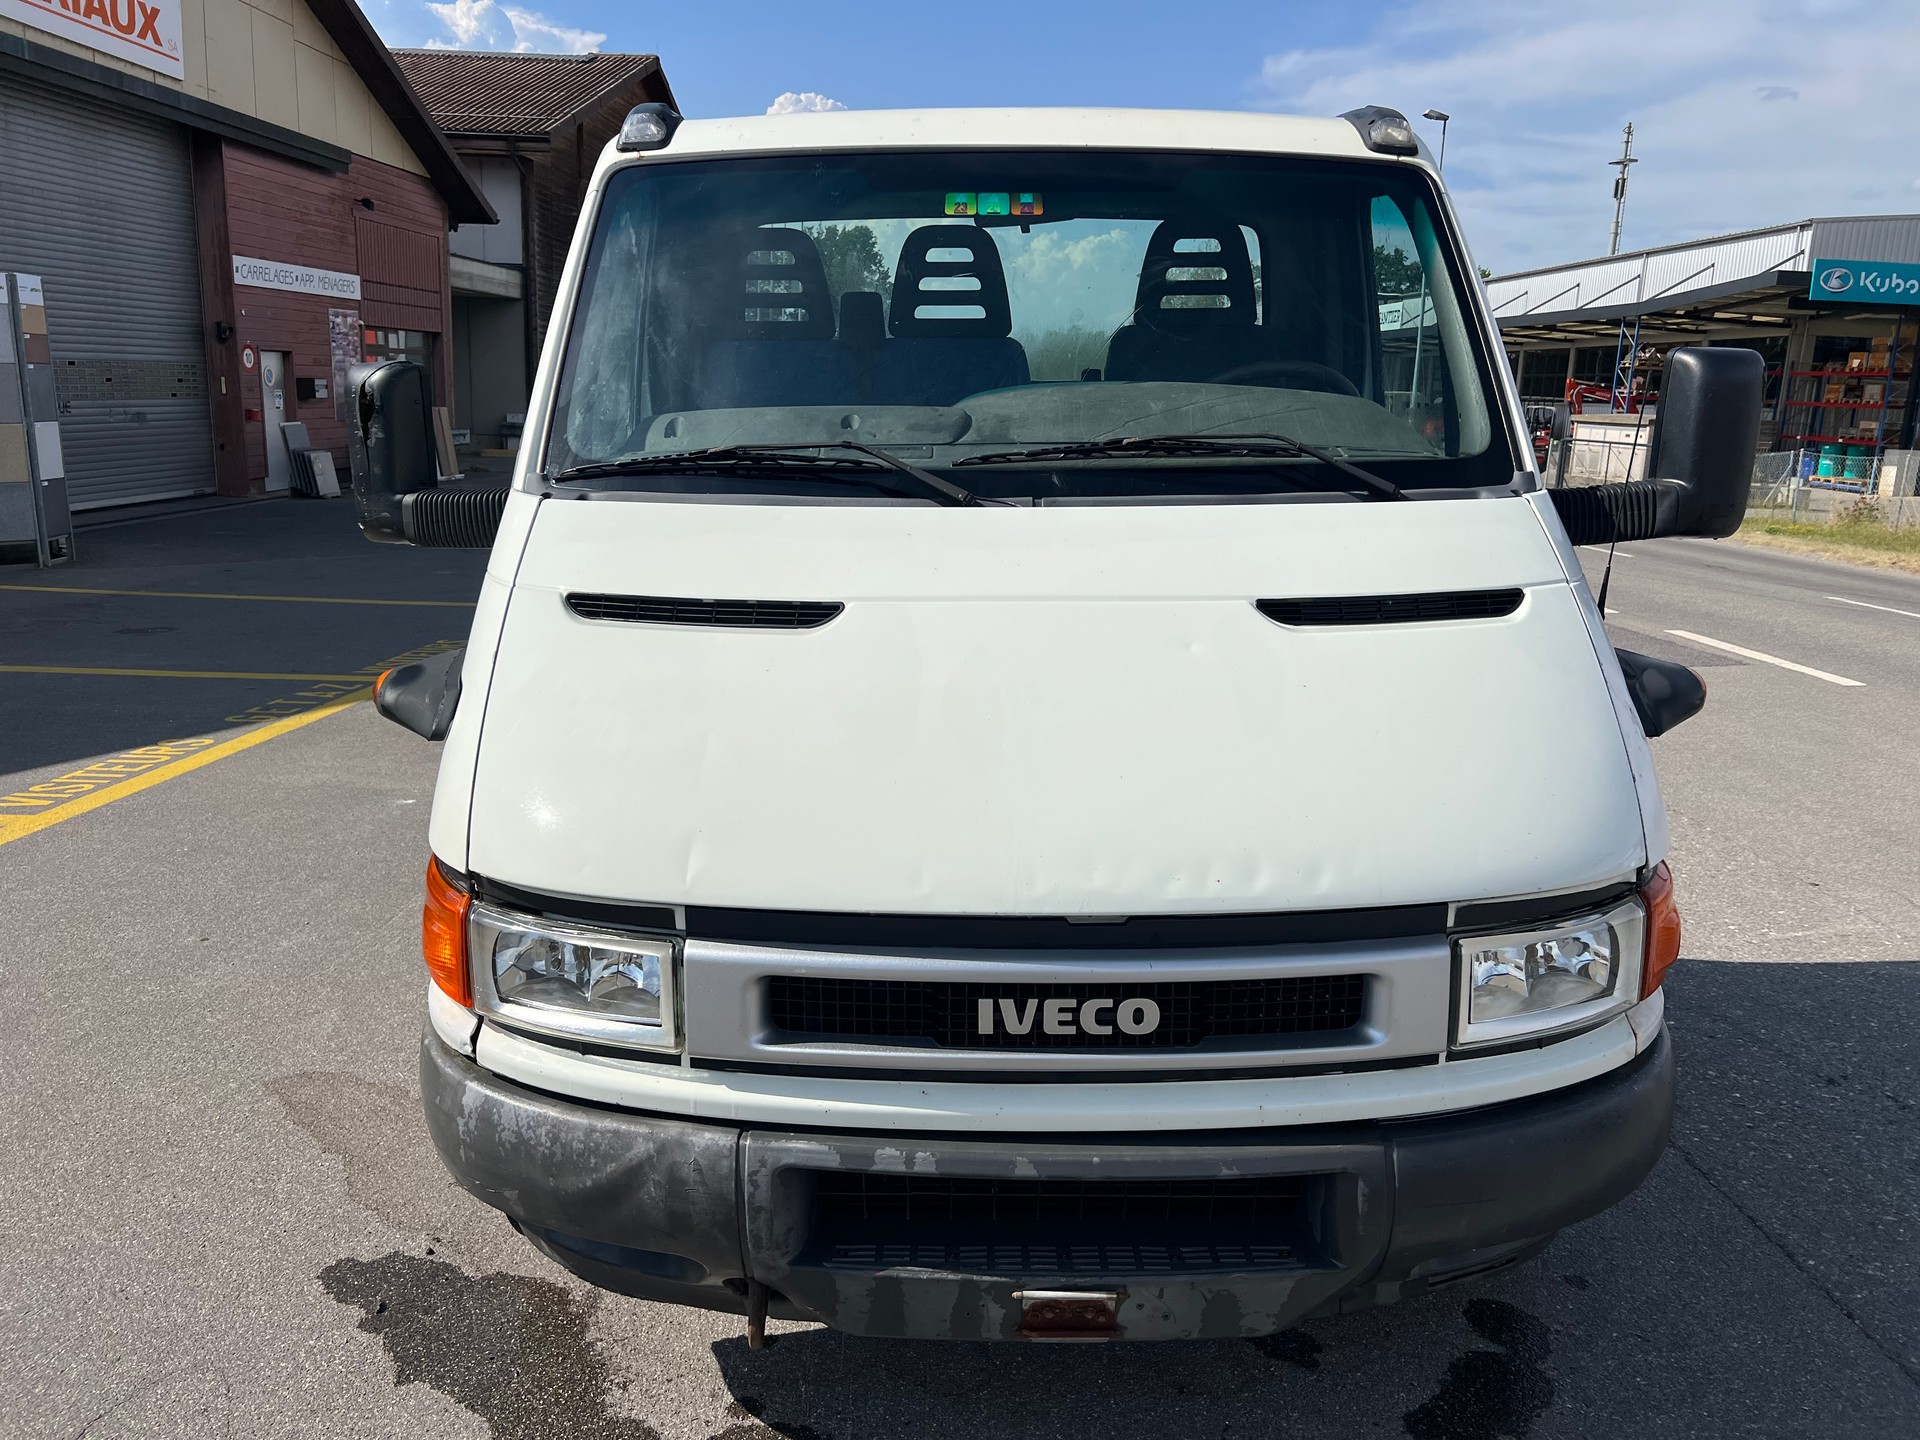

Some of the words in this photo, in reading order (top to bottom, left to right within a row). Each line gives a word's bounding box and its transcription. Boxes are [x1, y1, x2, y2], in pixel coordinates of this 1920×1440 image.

[168, 39, 179, 53] SA
[954, 202, 968, 212] 23
[240, 263, 294, 286] CARRELAGES
[299, 273, 315, 289] APP.
[318, 273, 356, 294] MÉNAGERS
[0, 738, 215, 807] VISITEURS
[978, 998, 1161, 1035] IVECO
